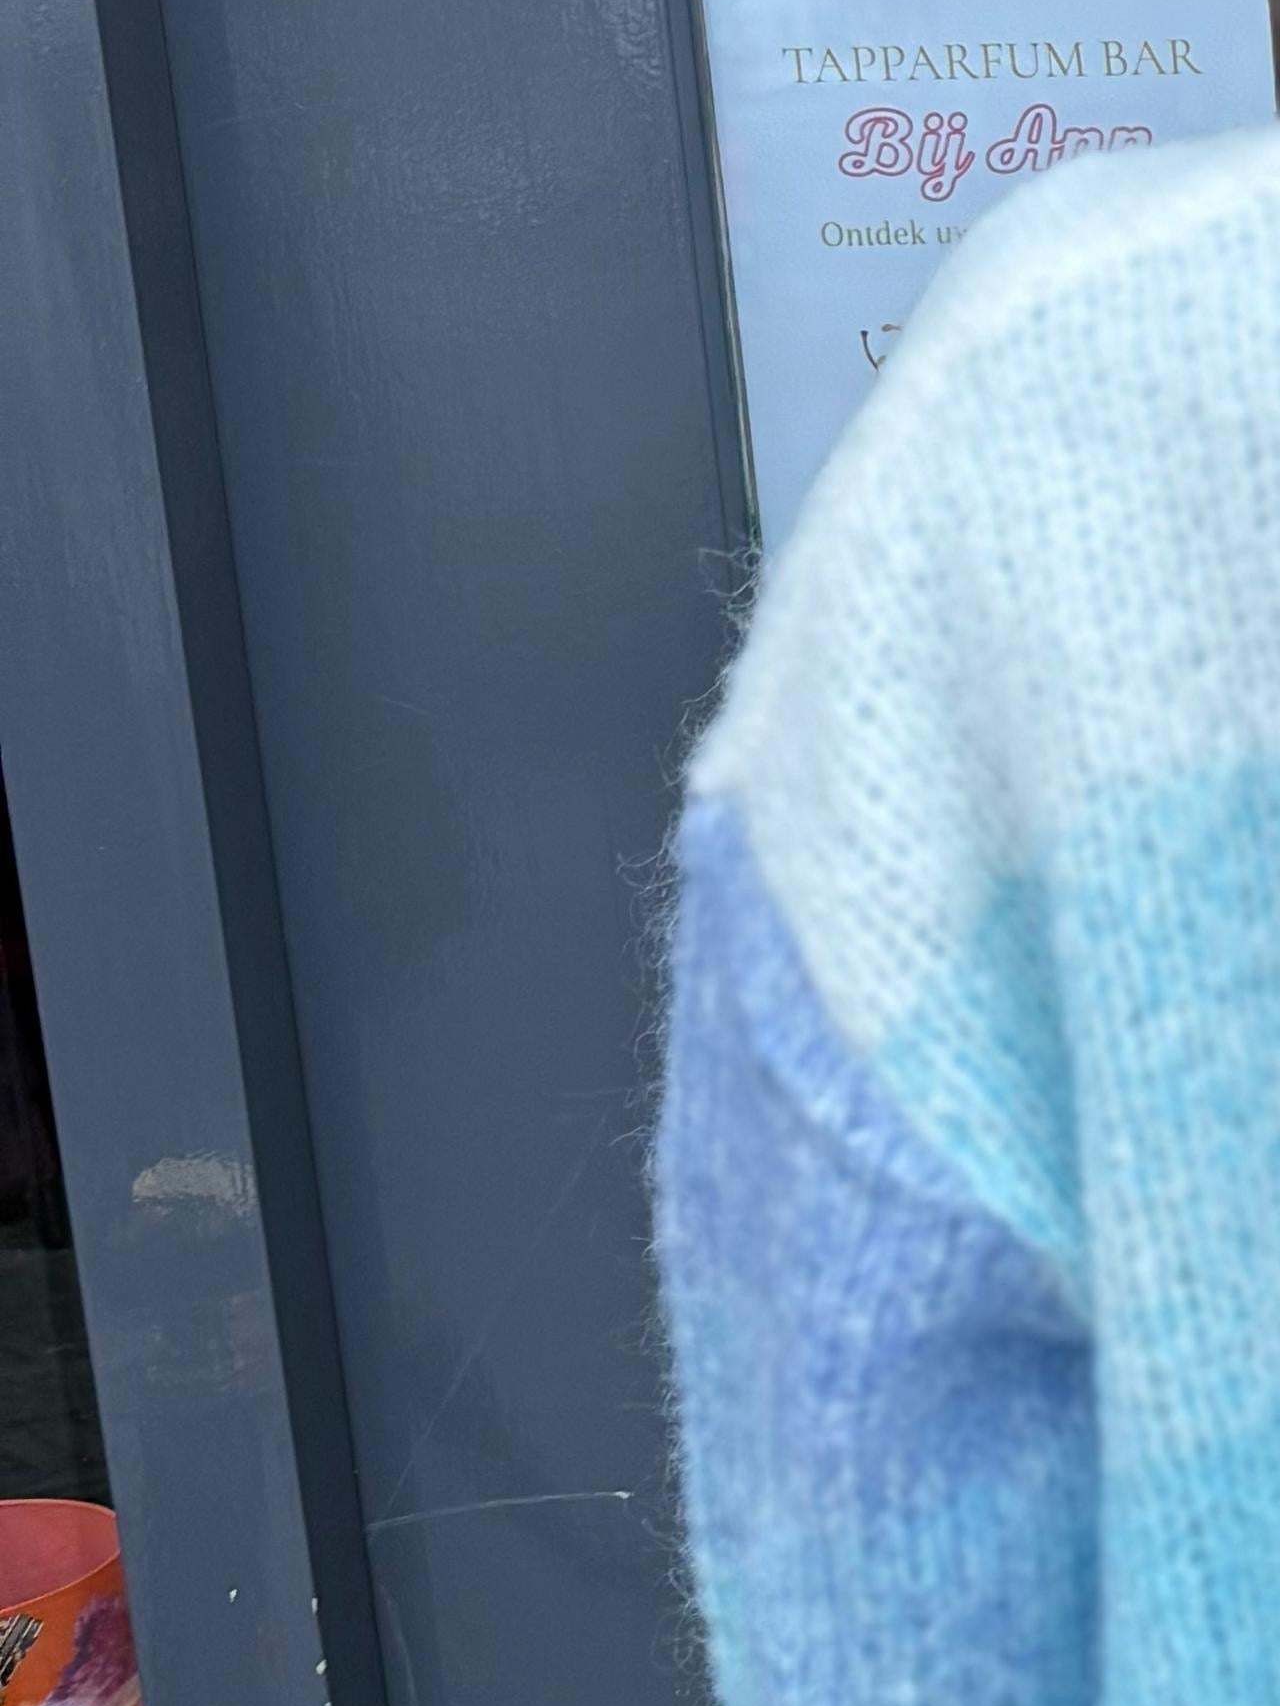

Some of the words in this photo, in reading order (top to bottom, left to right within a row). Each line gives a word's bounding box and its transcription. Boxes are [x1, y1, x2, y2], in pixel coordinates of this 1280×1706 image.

[782, 42, 1086, 84] TAPPARFUM
[1101, 38, 1204, 77] BAR
[839, 107, 976, 202] Bij
[820, 219, 927, 247] Ontdek
